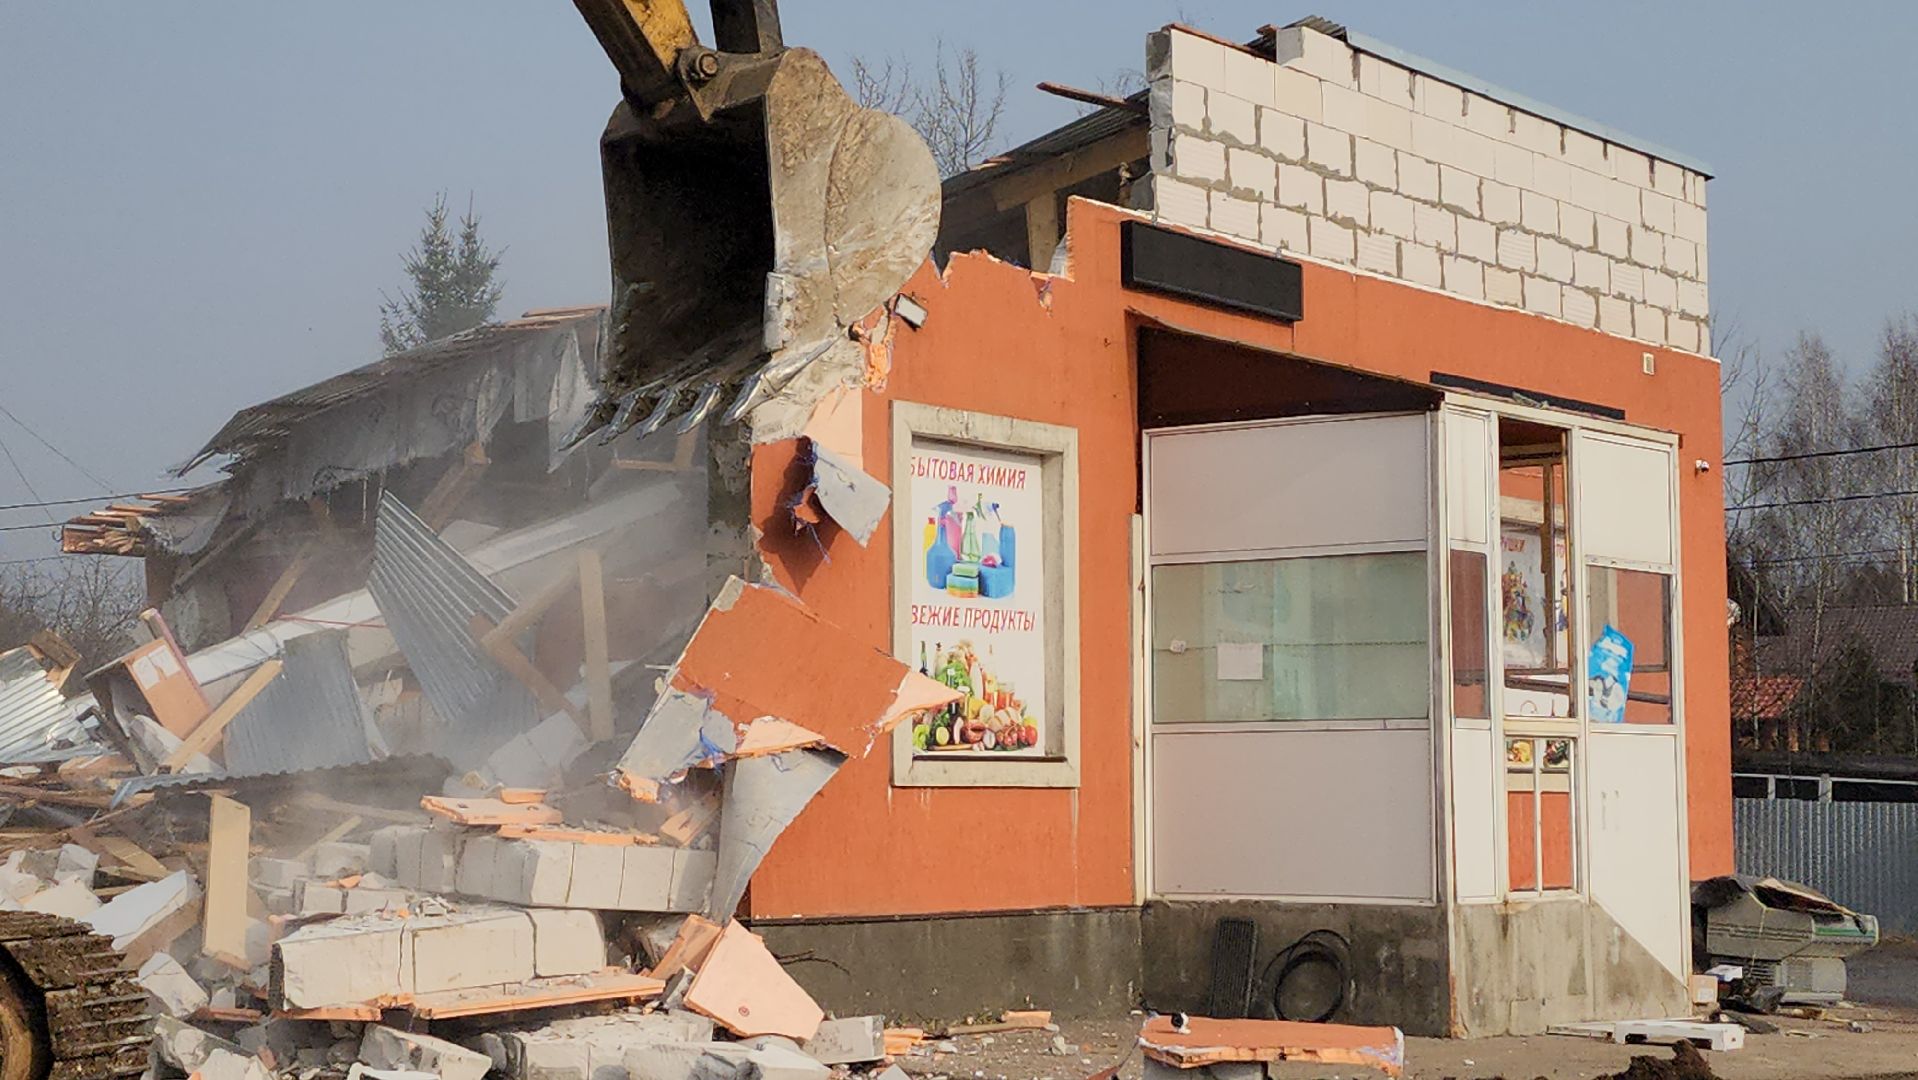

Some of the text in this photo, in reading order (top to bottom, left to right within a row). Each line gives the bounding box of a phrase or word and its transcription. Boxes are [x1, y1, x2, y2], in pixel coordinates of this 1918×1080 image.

[977, 464, 1026, 490] ХИМИЯ
[911, 604, 1036, 633] ВЕЖИЕ ПРОДУКТЫ
